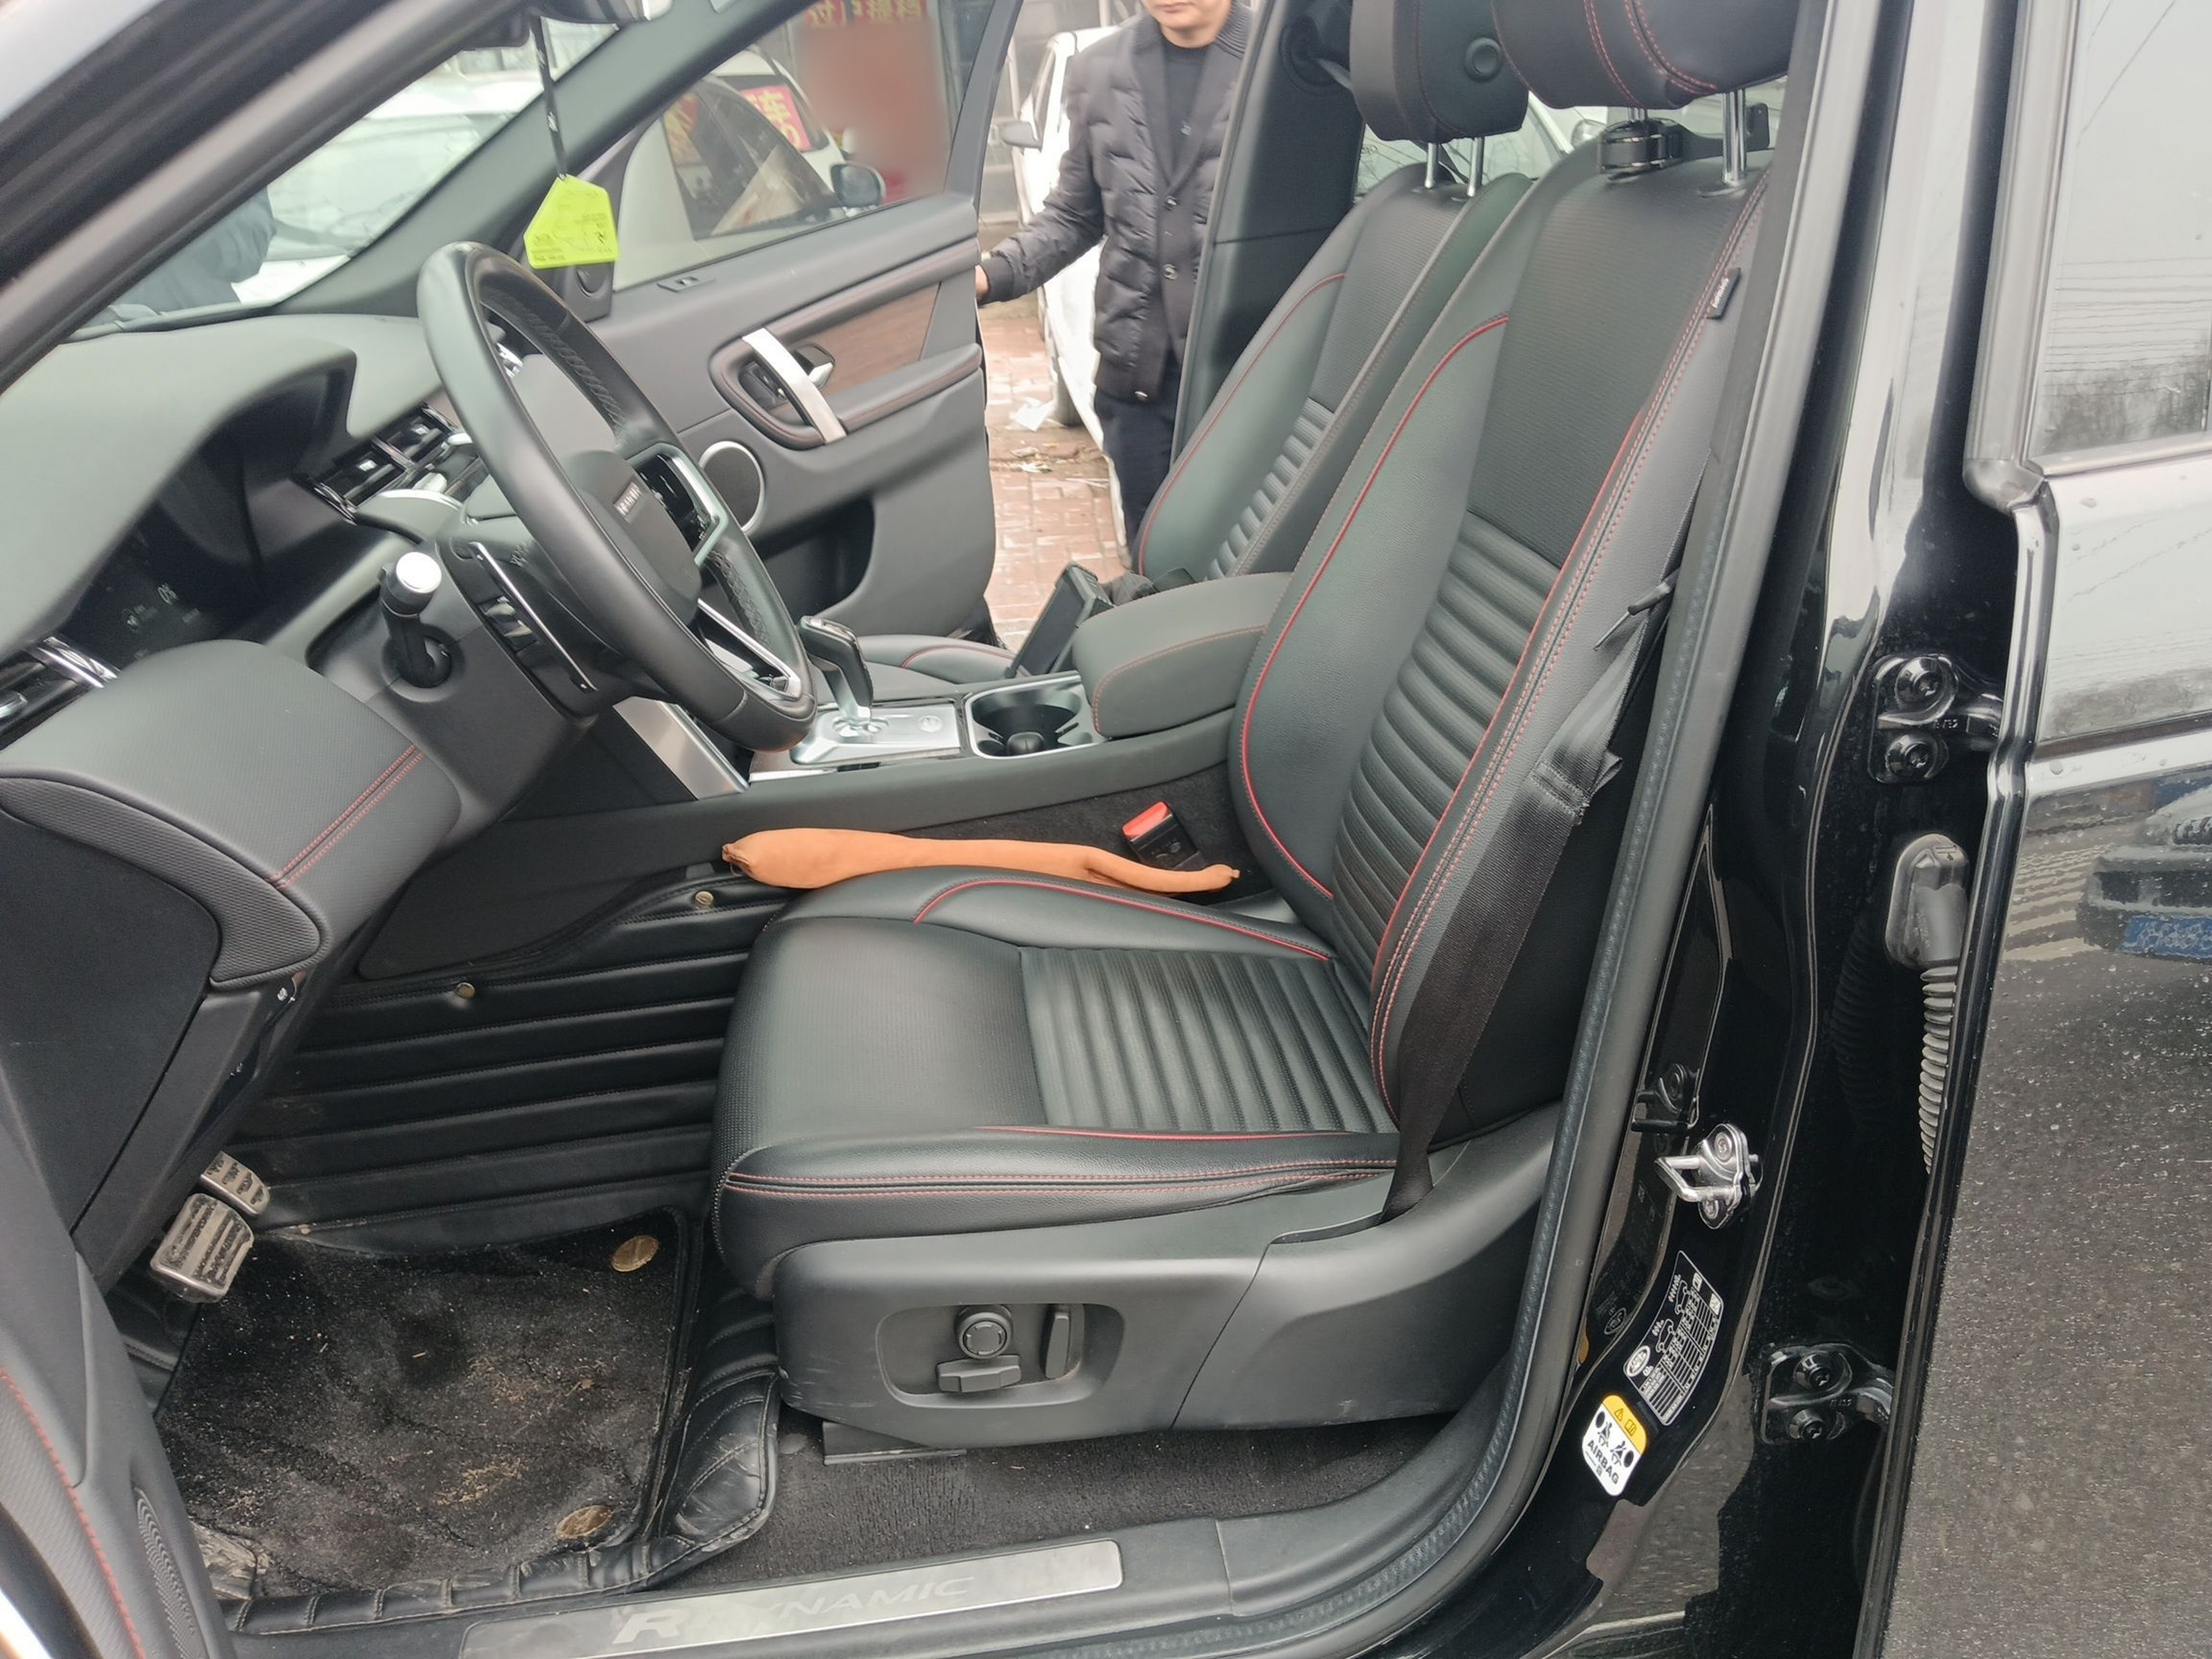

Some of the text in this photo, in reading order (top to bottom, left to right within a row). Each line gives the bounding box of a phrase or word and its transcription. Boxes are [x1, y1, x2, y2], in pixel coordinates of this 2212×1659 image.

[1587, 1439, 1620, 1485] AIRBAG
[612, 1576, 975, 1645] R YNAMIC
